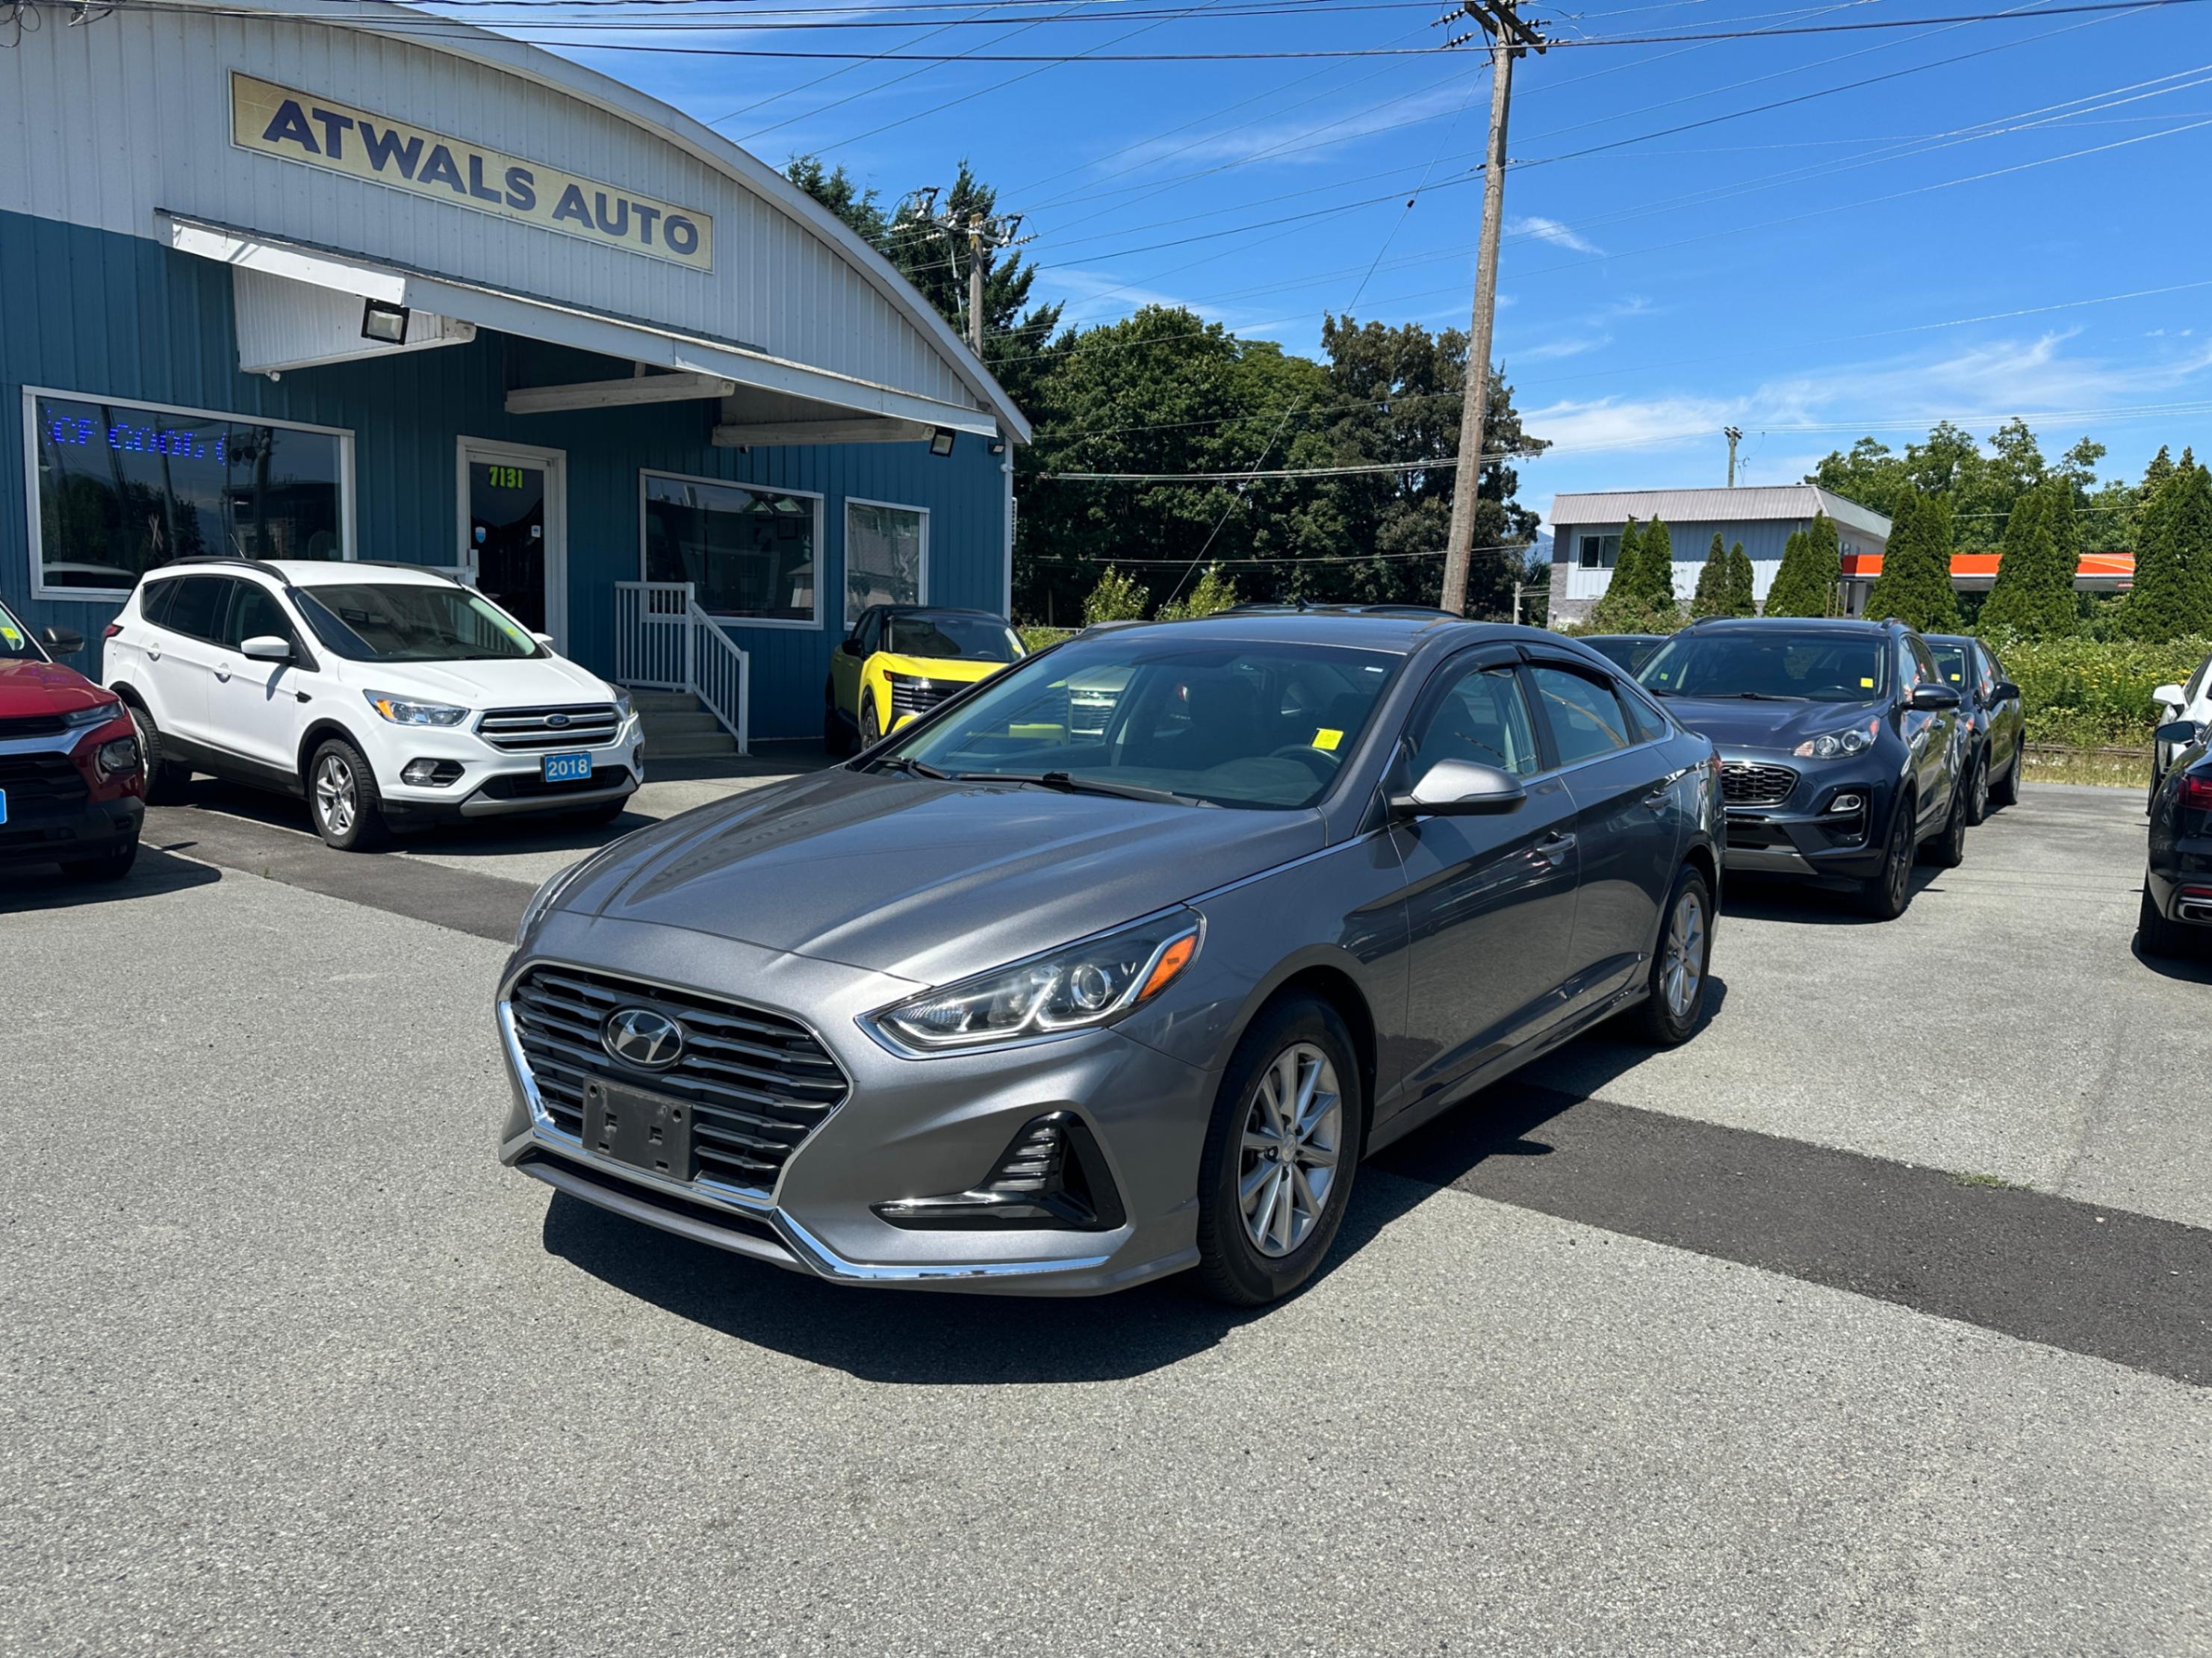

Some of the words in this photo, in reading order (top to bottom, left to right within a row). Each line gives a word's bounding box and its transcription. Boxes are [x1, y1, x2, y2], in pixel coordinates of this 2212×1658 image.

[262, 99, 536, 211] ATWALS
[552, 184, 699, 255] AUTO
[489, 465, 523, 489] 7131
[547, 758, 588, 777] 2018
